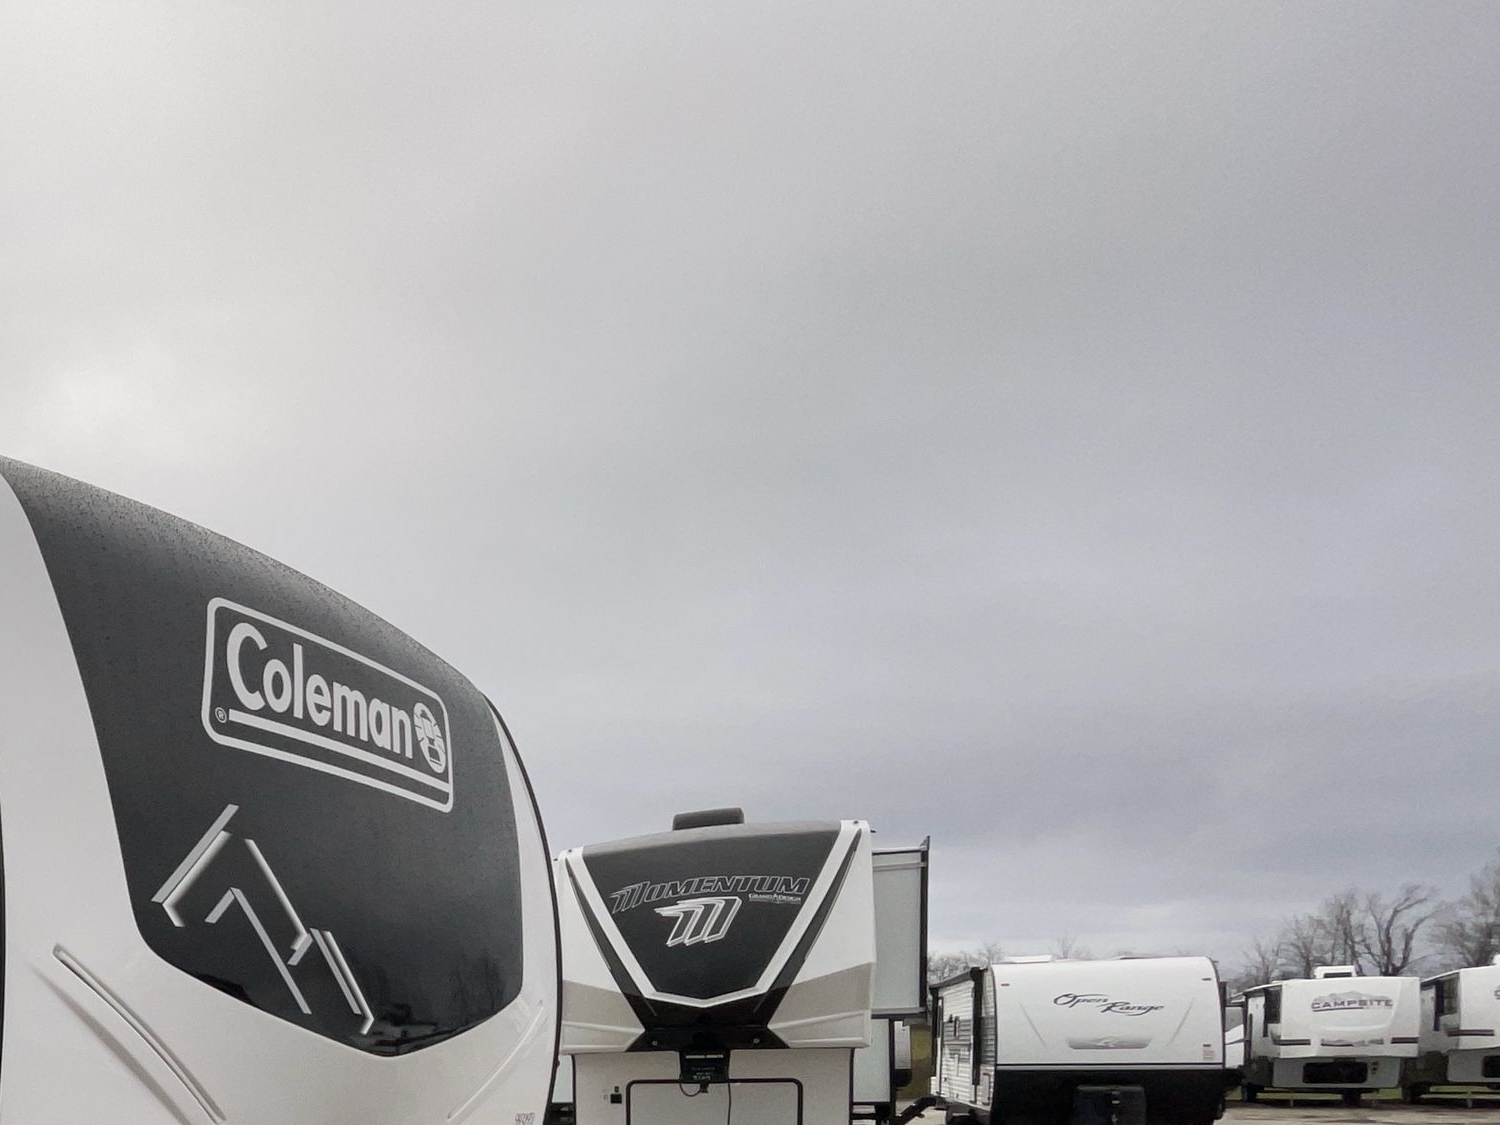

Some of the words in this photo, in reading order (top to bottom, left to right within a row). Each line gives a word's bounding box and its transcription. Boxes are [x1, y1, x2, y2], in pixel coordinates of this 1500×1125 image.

[226, 622, 413, 760] Coleman
[609, 875, 811, 914] MOMENTUM
[1053, 993, 1110, 1008] Open
[1096, 1001, 1164, 1016] Range
